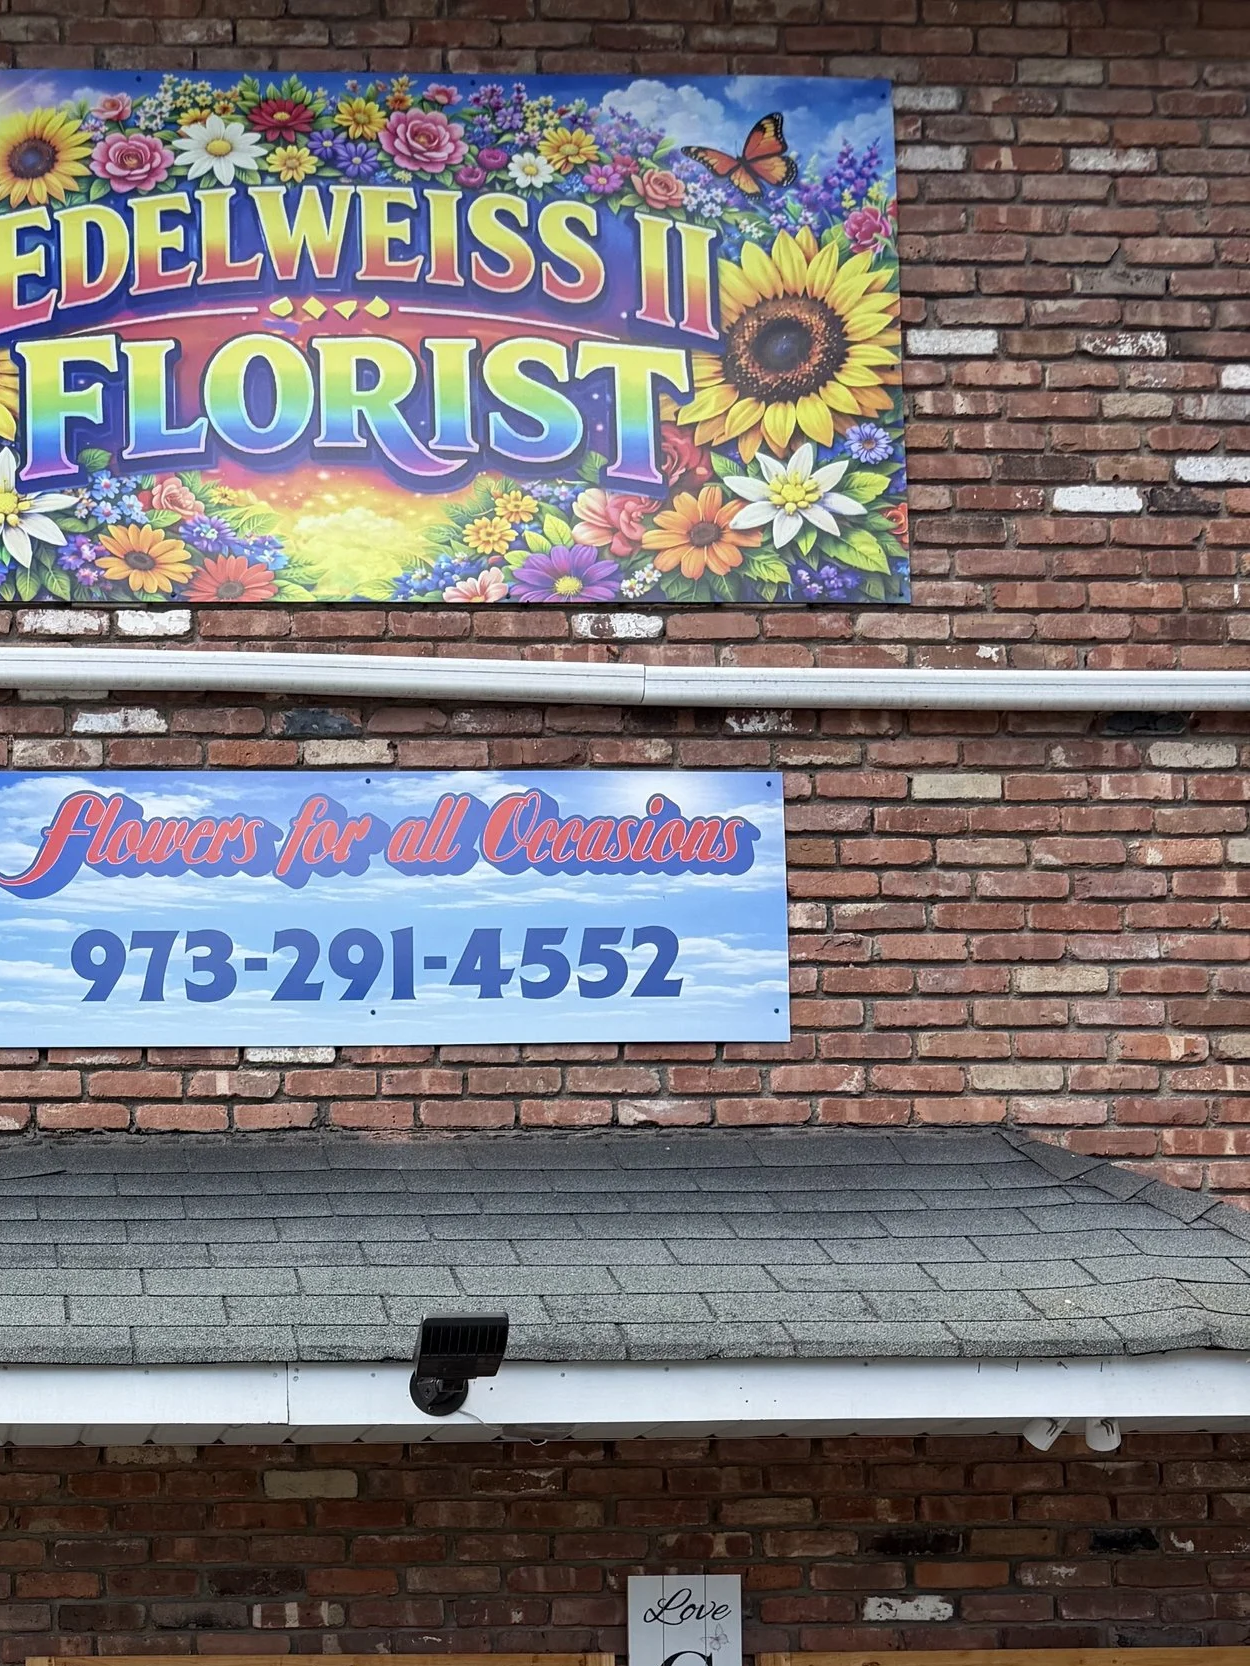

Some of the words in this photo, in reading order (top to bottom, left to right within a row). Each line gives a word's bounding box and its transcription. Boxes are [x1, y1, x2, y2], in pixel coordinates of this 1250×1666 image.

[633, 211, 721, 337] II
[18, 334, 694, 487] FLORIST
[273, 795, 376, 881] for
[385, 793, 468, 867] all
[481, 789, 750, 867] Occasions
[70, 925, 685, 1003] 973-291-4552
[643, 1587, 732, 1626] Love
